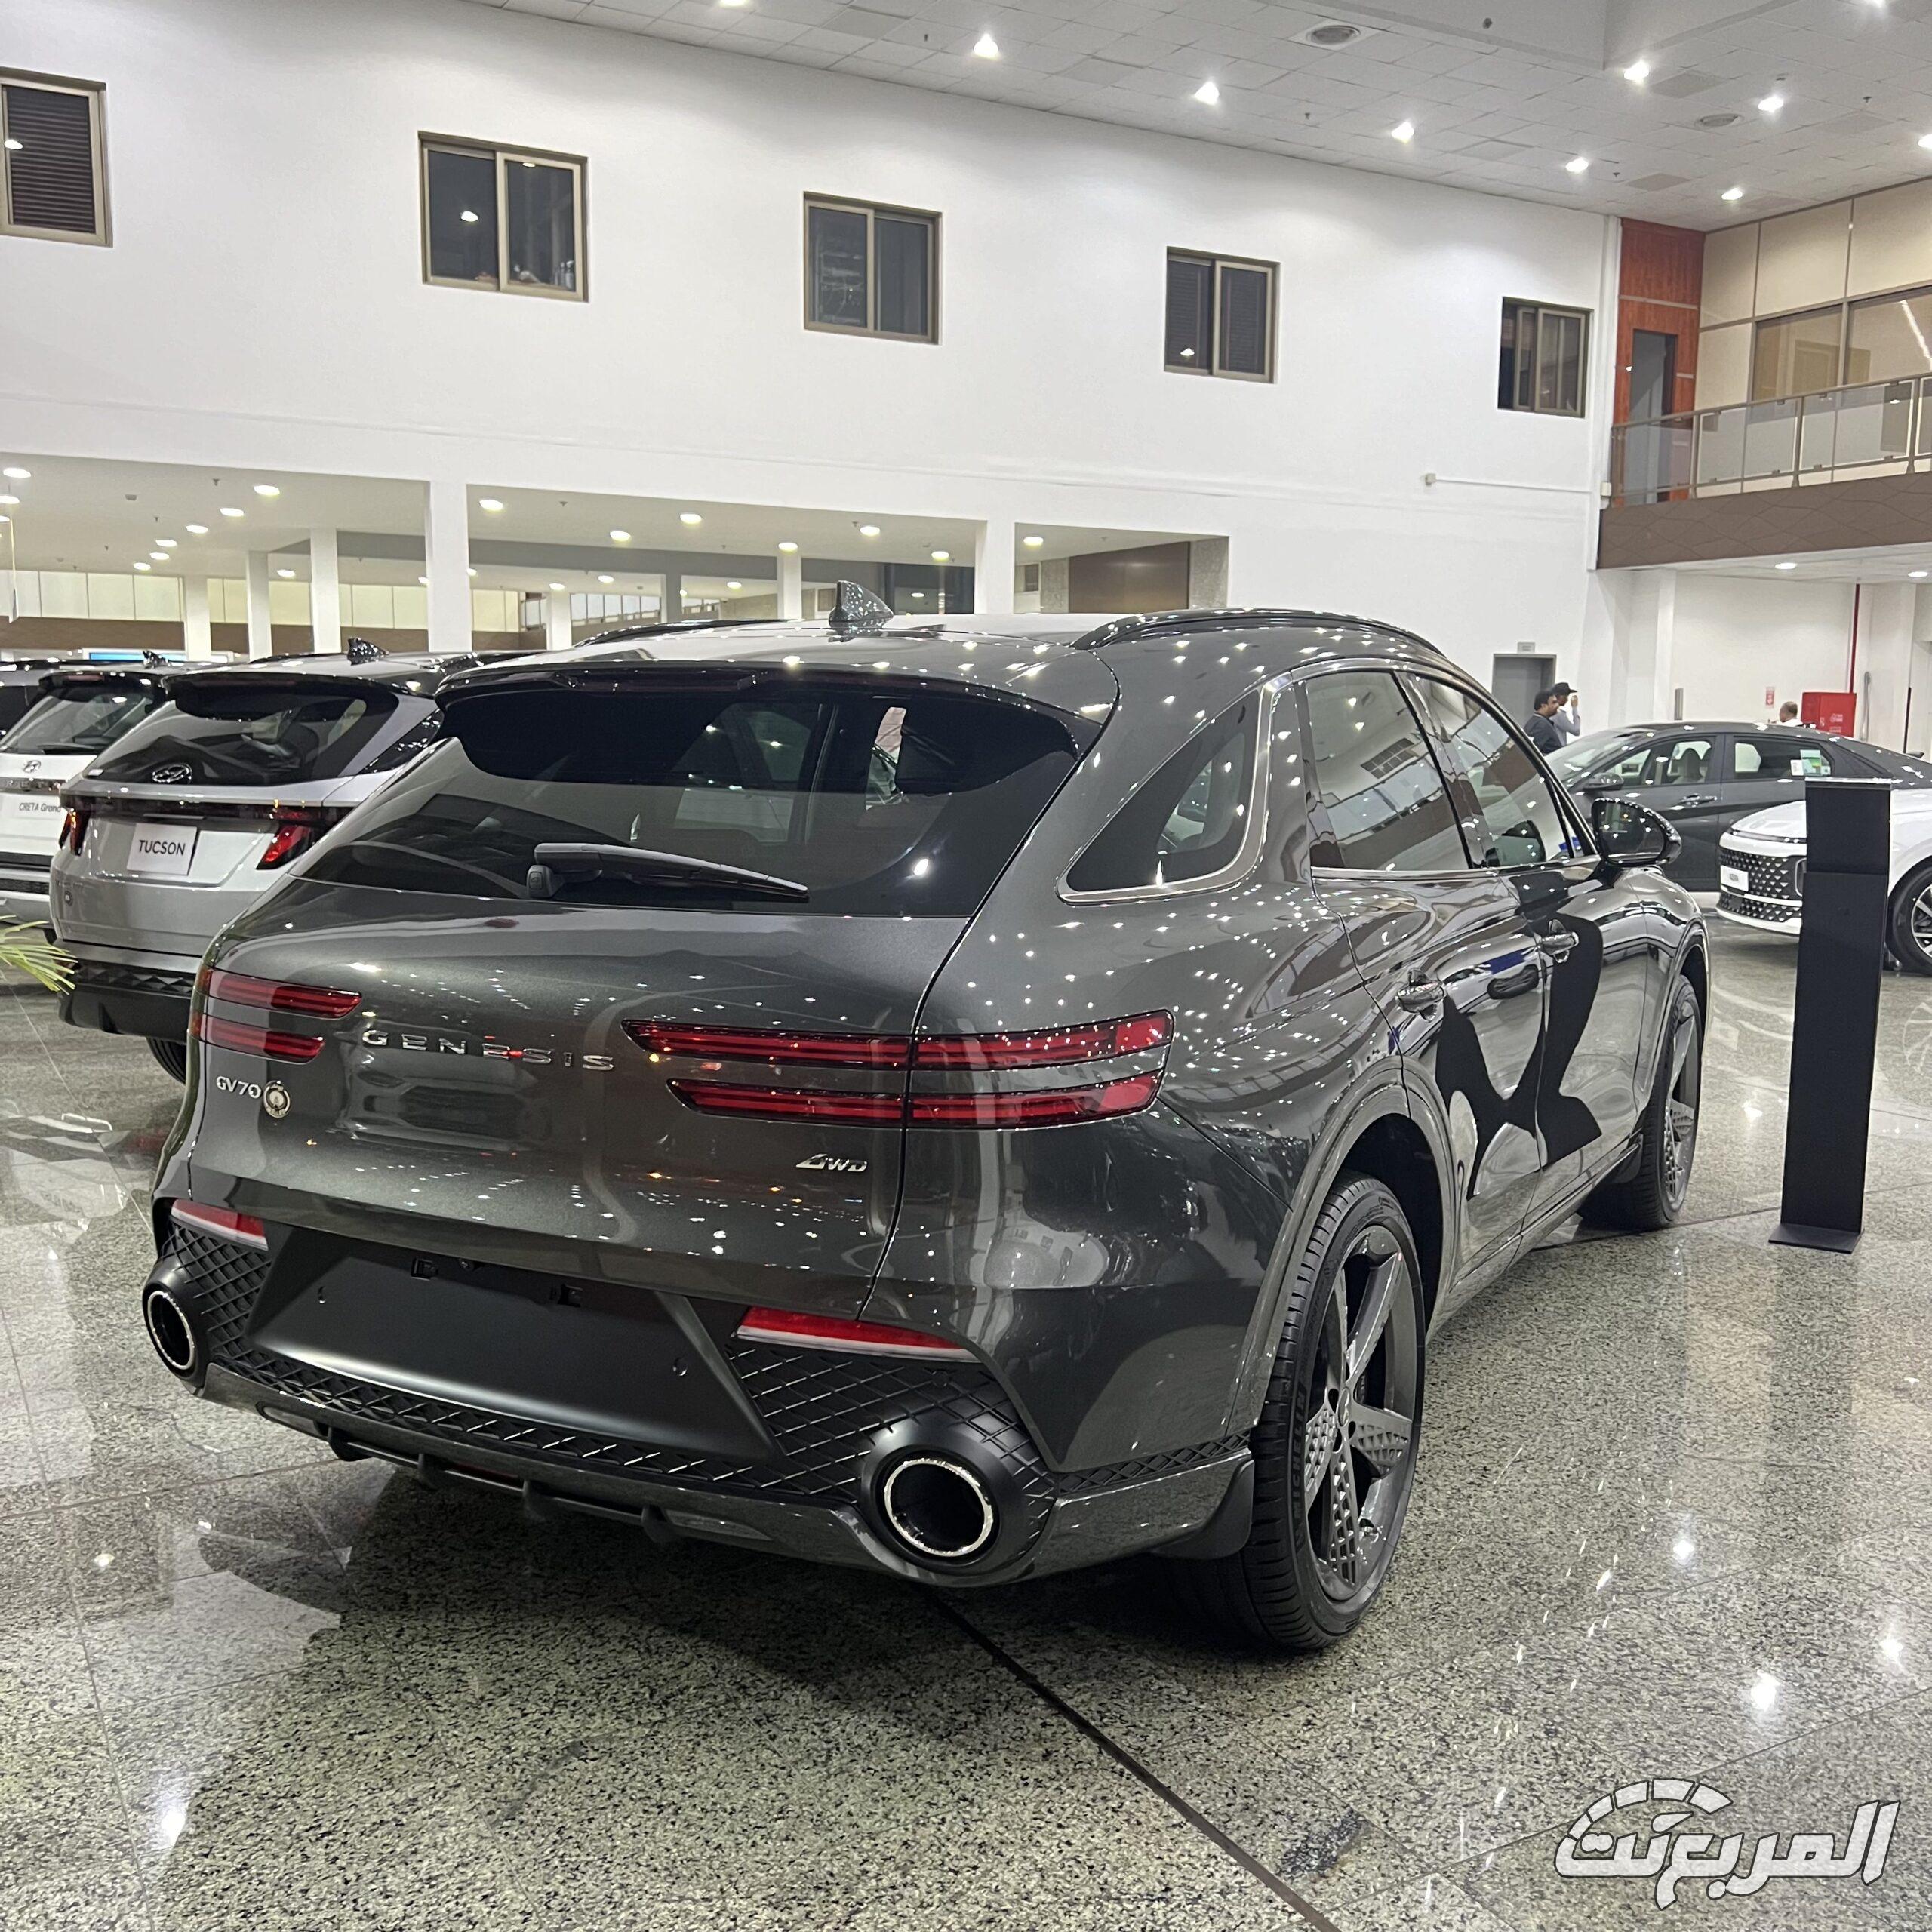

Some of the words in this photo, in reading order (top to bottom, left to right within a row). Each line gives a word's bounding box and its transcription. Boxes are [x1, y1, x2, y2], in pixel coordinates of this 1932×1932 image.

[19, 802, 39, 811] CRETA
[139, 839, 186, 856] TUCSON
[362, 1029, 614, 1071] GENESIS
[216, 1075, 262, 1099] GV70
[795, 1153, 868, 1172] 4WD
[1291, 1391, 1306, 1519] MICHELIN
